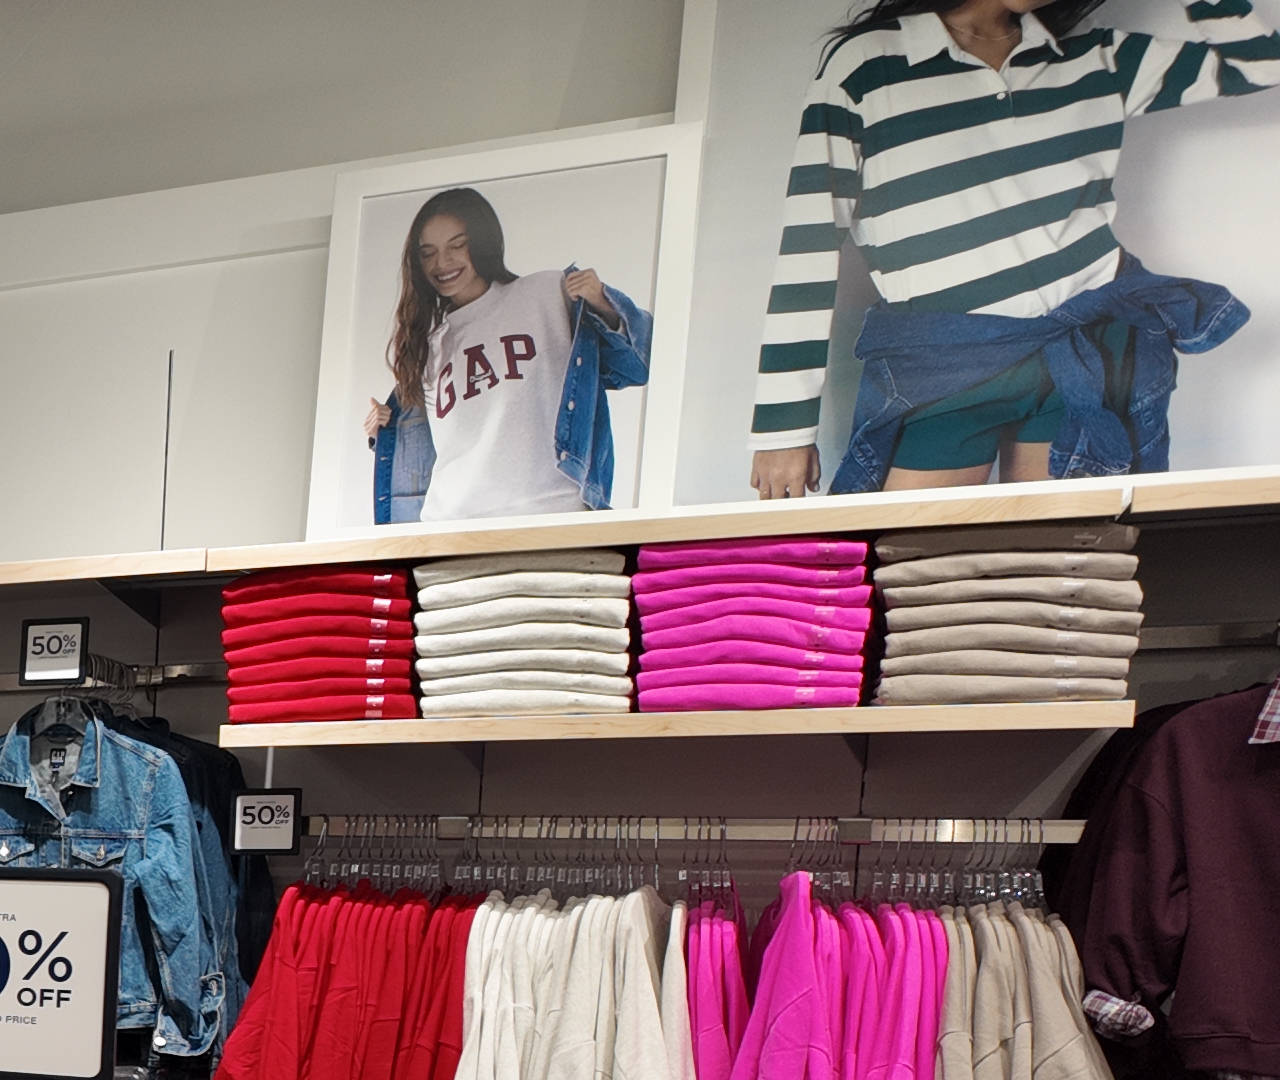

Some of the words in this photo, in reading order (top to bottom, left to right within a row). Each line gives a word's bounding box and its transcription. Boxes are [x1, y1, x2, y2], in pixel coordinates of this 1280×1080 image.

[436, 333, 537, 419] GAP
[31, 634, 77, 656] 50%
[241, 805, 290, 825] 50%
[16, 987, 72, 1008] OFF
[5, 1015, 37, 1025] PRICE
